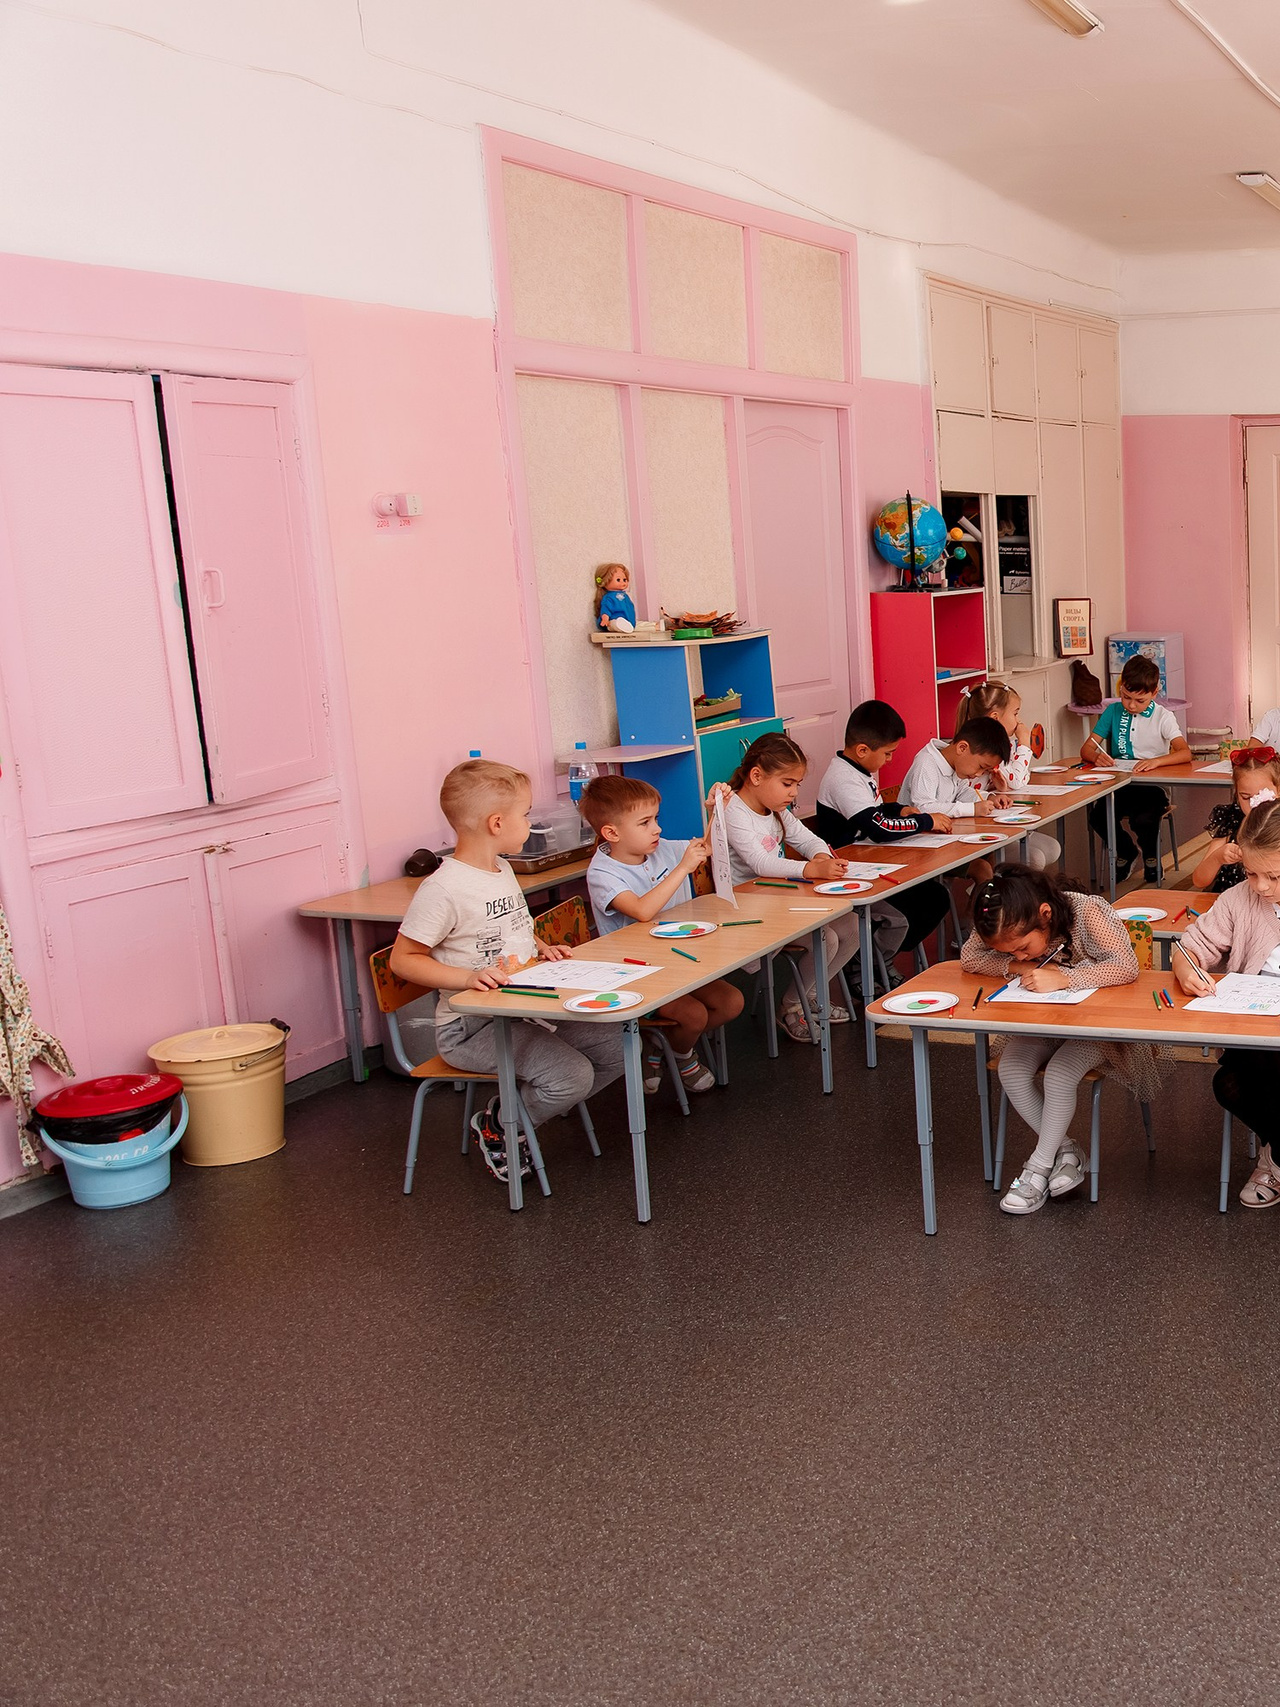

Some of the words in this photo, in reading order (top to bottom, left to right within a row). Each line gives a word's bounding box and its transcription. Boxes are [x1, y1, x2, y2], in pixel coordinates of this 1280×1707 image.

[1119, 711, 1130, 728] STAY
[622, 1022, 631, 1033] 2
[633, 1021, 639, 1034] 2
